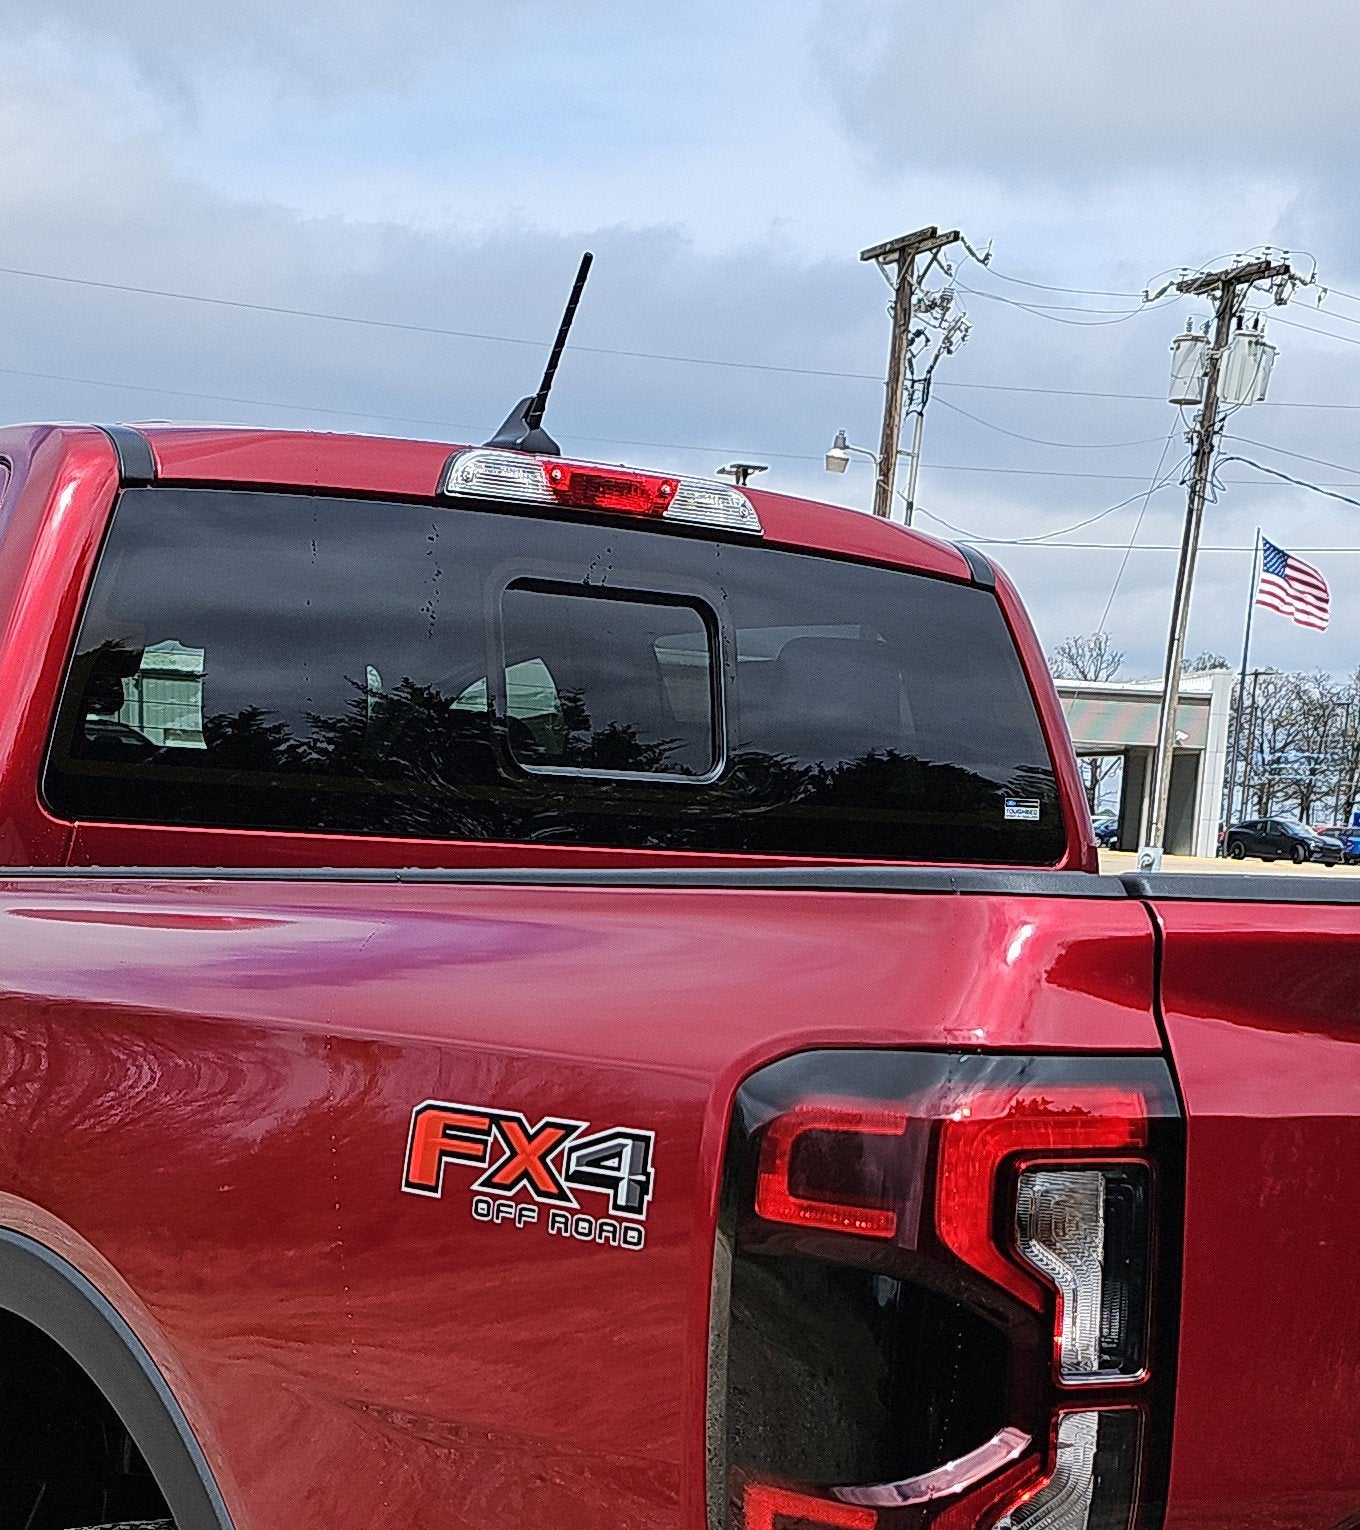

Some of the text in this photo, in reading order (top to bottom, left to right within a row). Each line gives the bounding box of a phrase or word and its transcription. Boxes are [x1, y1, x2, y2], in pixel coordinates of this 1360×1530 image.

[401, 1099, 656, 1221] FX4
[472, 1195, 646, 1251] OFF ROAD
